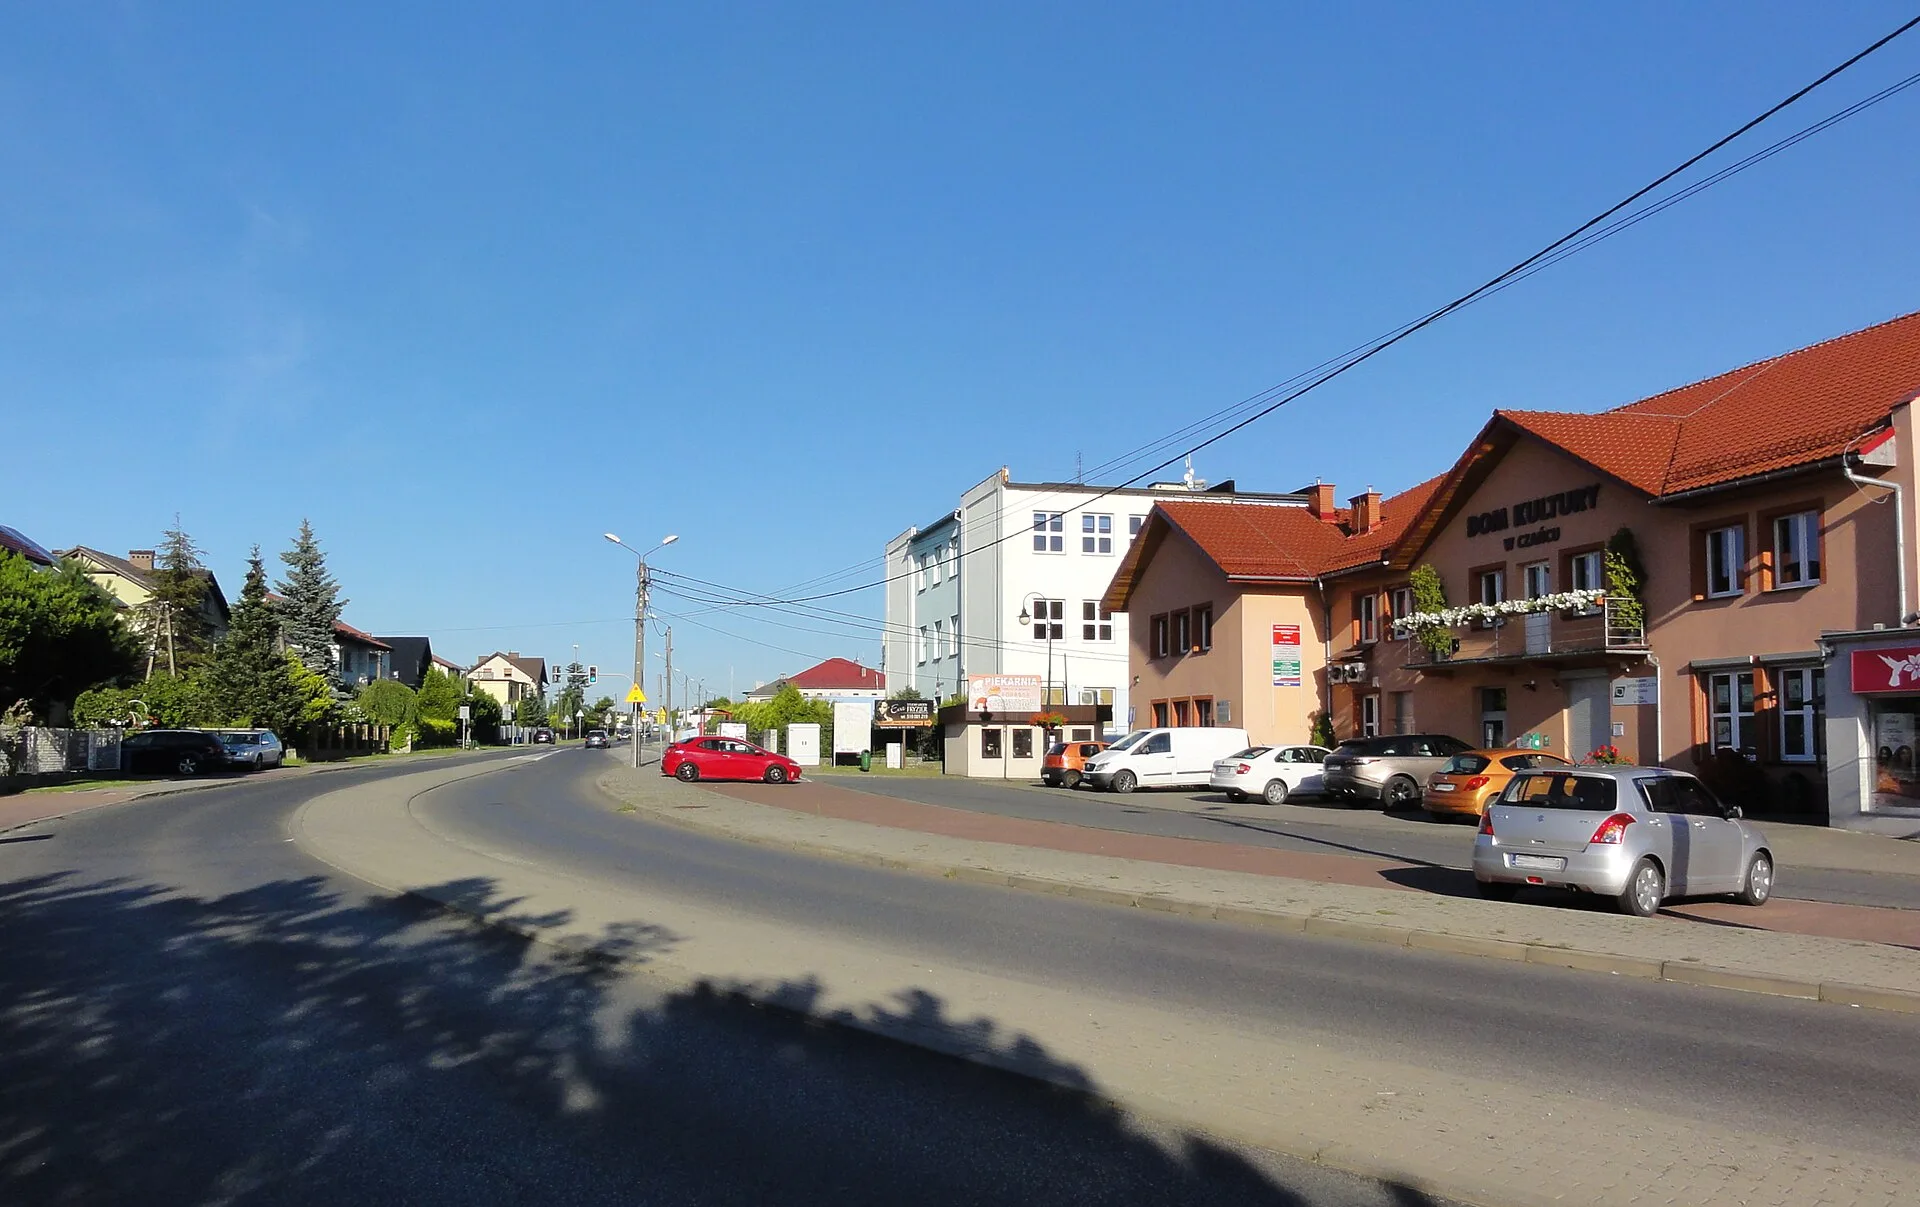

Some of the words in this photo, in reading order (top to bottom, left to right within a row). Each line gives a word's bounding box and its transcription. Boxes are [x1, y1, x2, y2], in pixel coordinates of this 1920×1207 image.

[1466, 508, 1508, 537] DOM
[1513, 483, 1600, 528] KULTURY
[985, 677, 1038, 686] PIEKARNIA
